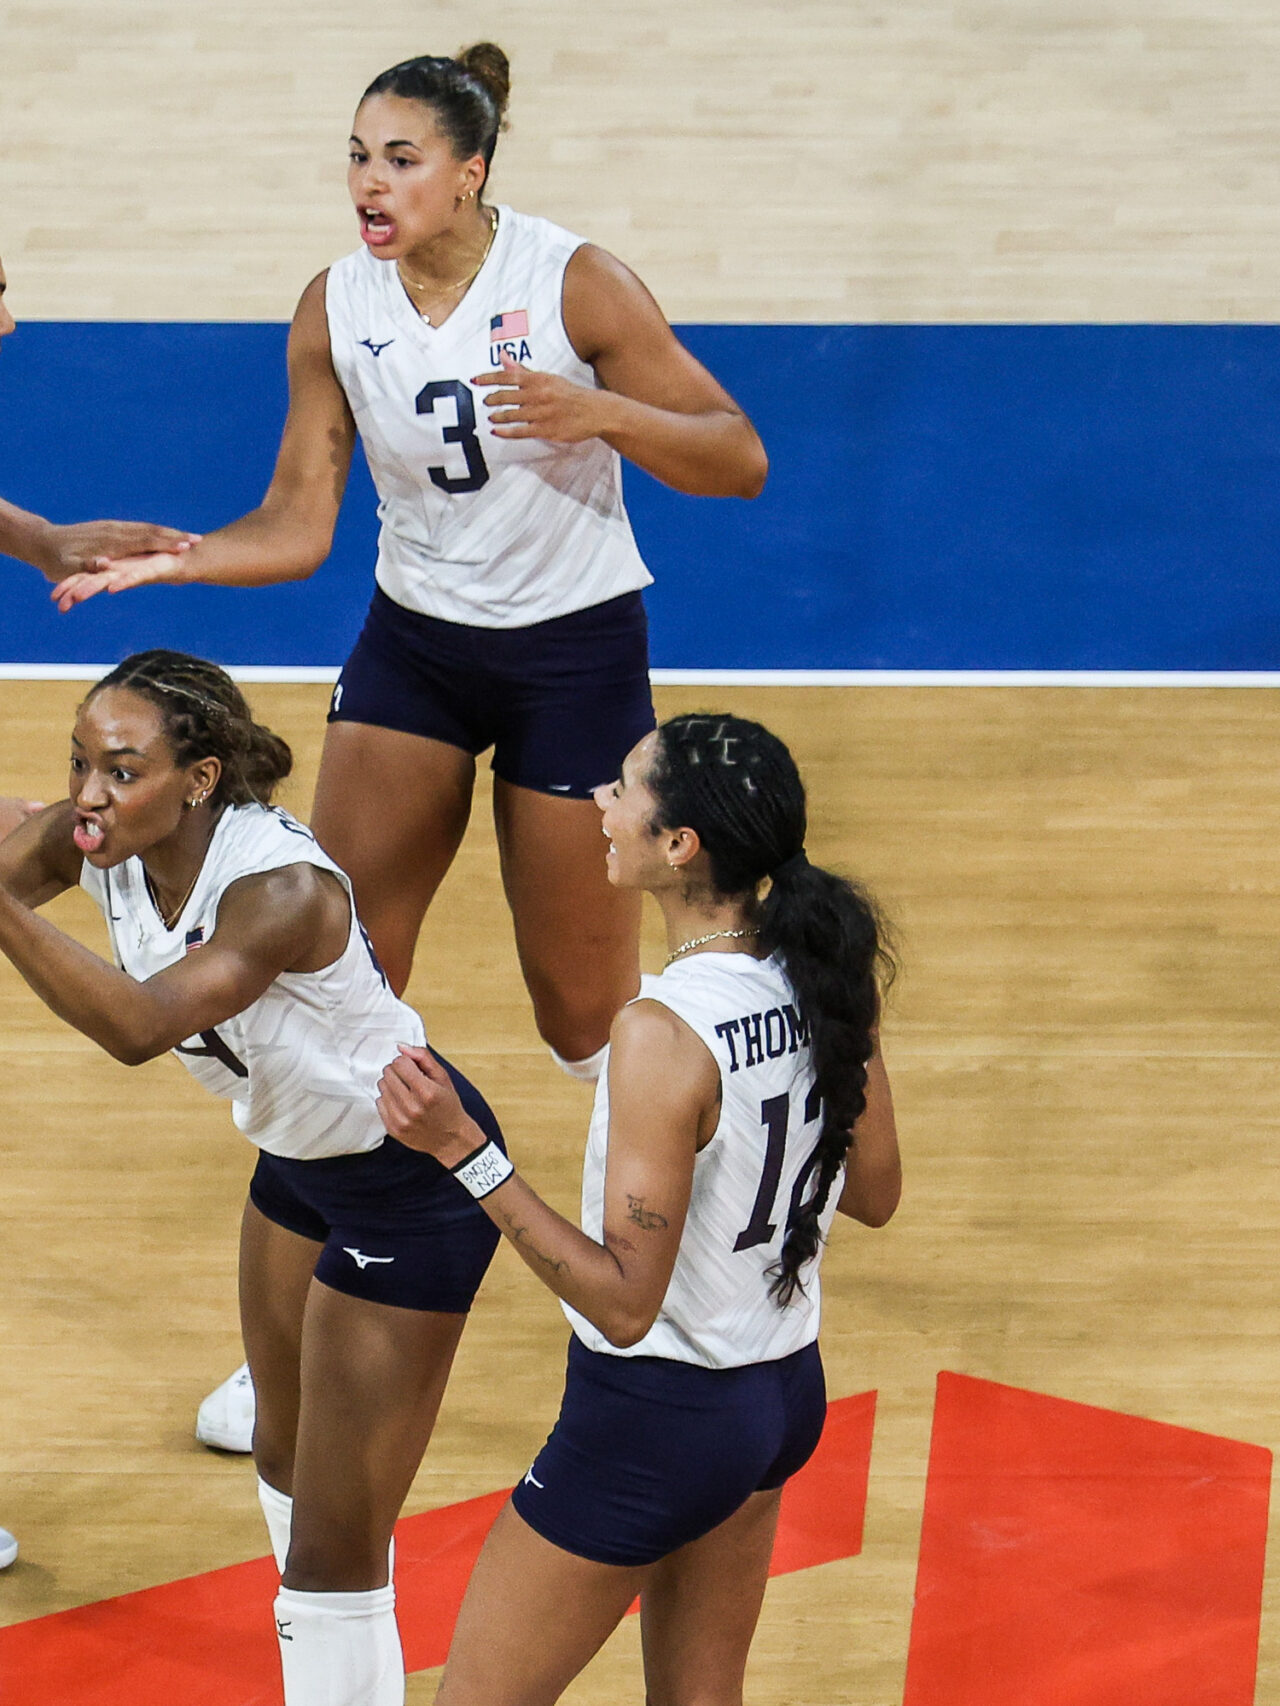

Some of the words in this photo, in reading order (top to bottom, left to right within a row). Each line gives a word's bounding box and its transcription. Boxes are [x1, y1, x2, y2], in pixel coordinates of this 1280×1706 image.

[490, 339, 532, 367] USA
[415, 379, 490, 494] 3
[714, 1003, 812, 1074] THOM
